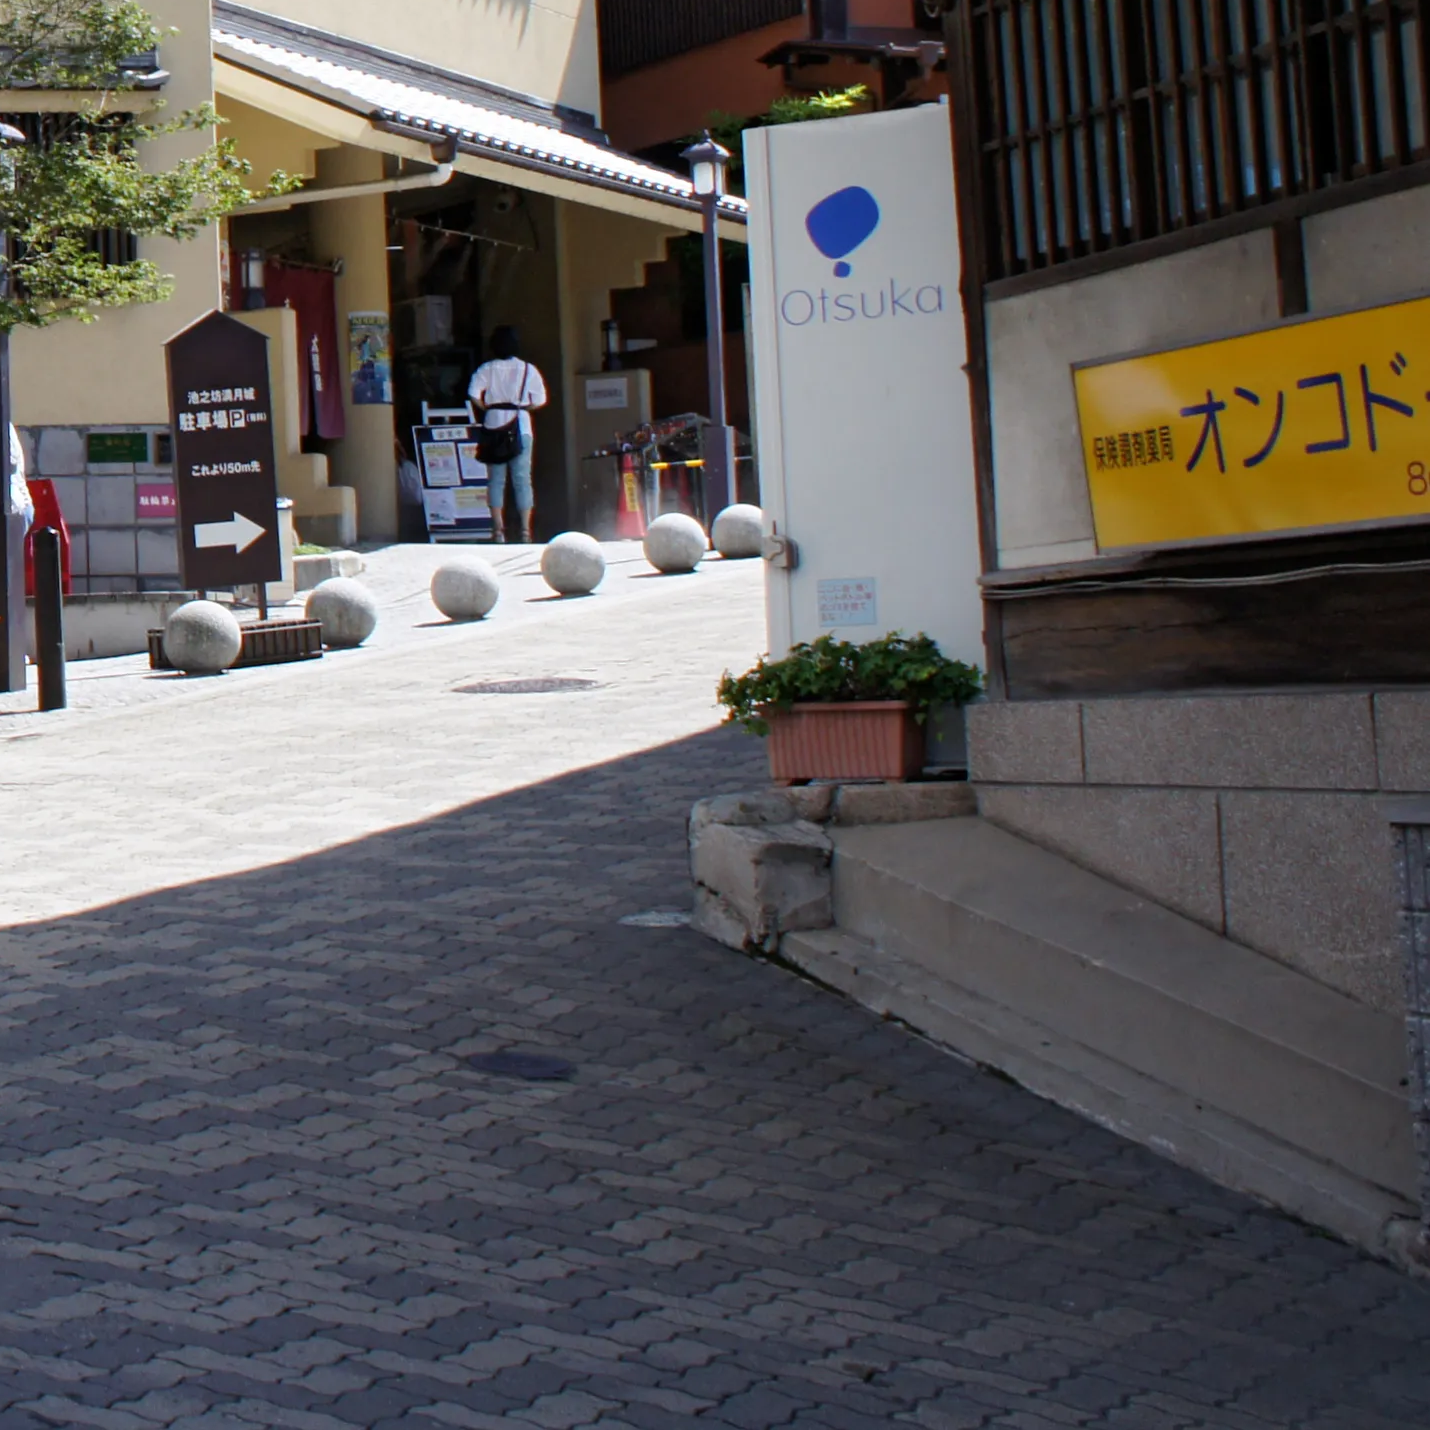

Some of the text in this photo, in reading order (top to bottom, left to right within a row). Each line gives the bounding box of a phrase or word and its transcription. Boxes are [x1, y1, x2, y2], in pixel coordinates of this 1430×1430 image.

[781, 278, 943, 326] Otsuka
[179, 410, 229, 432] 駐車場
[1093, 352, 1430, 473] 保険調剤薬局 オンコド
[191, 460, 262, 477] これより50m先
